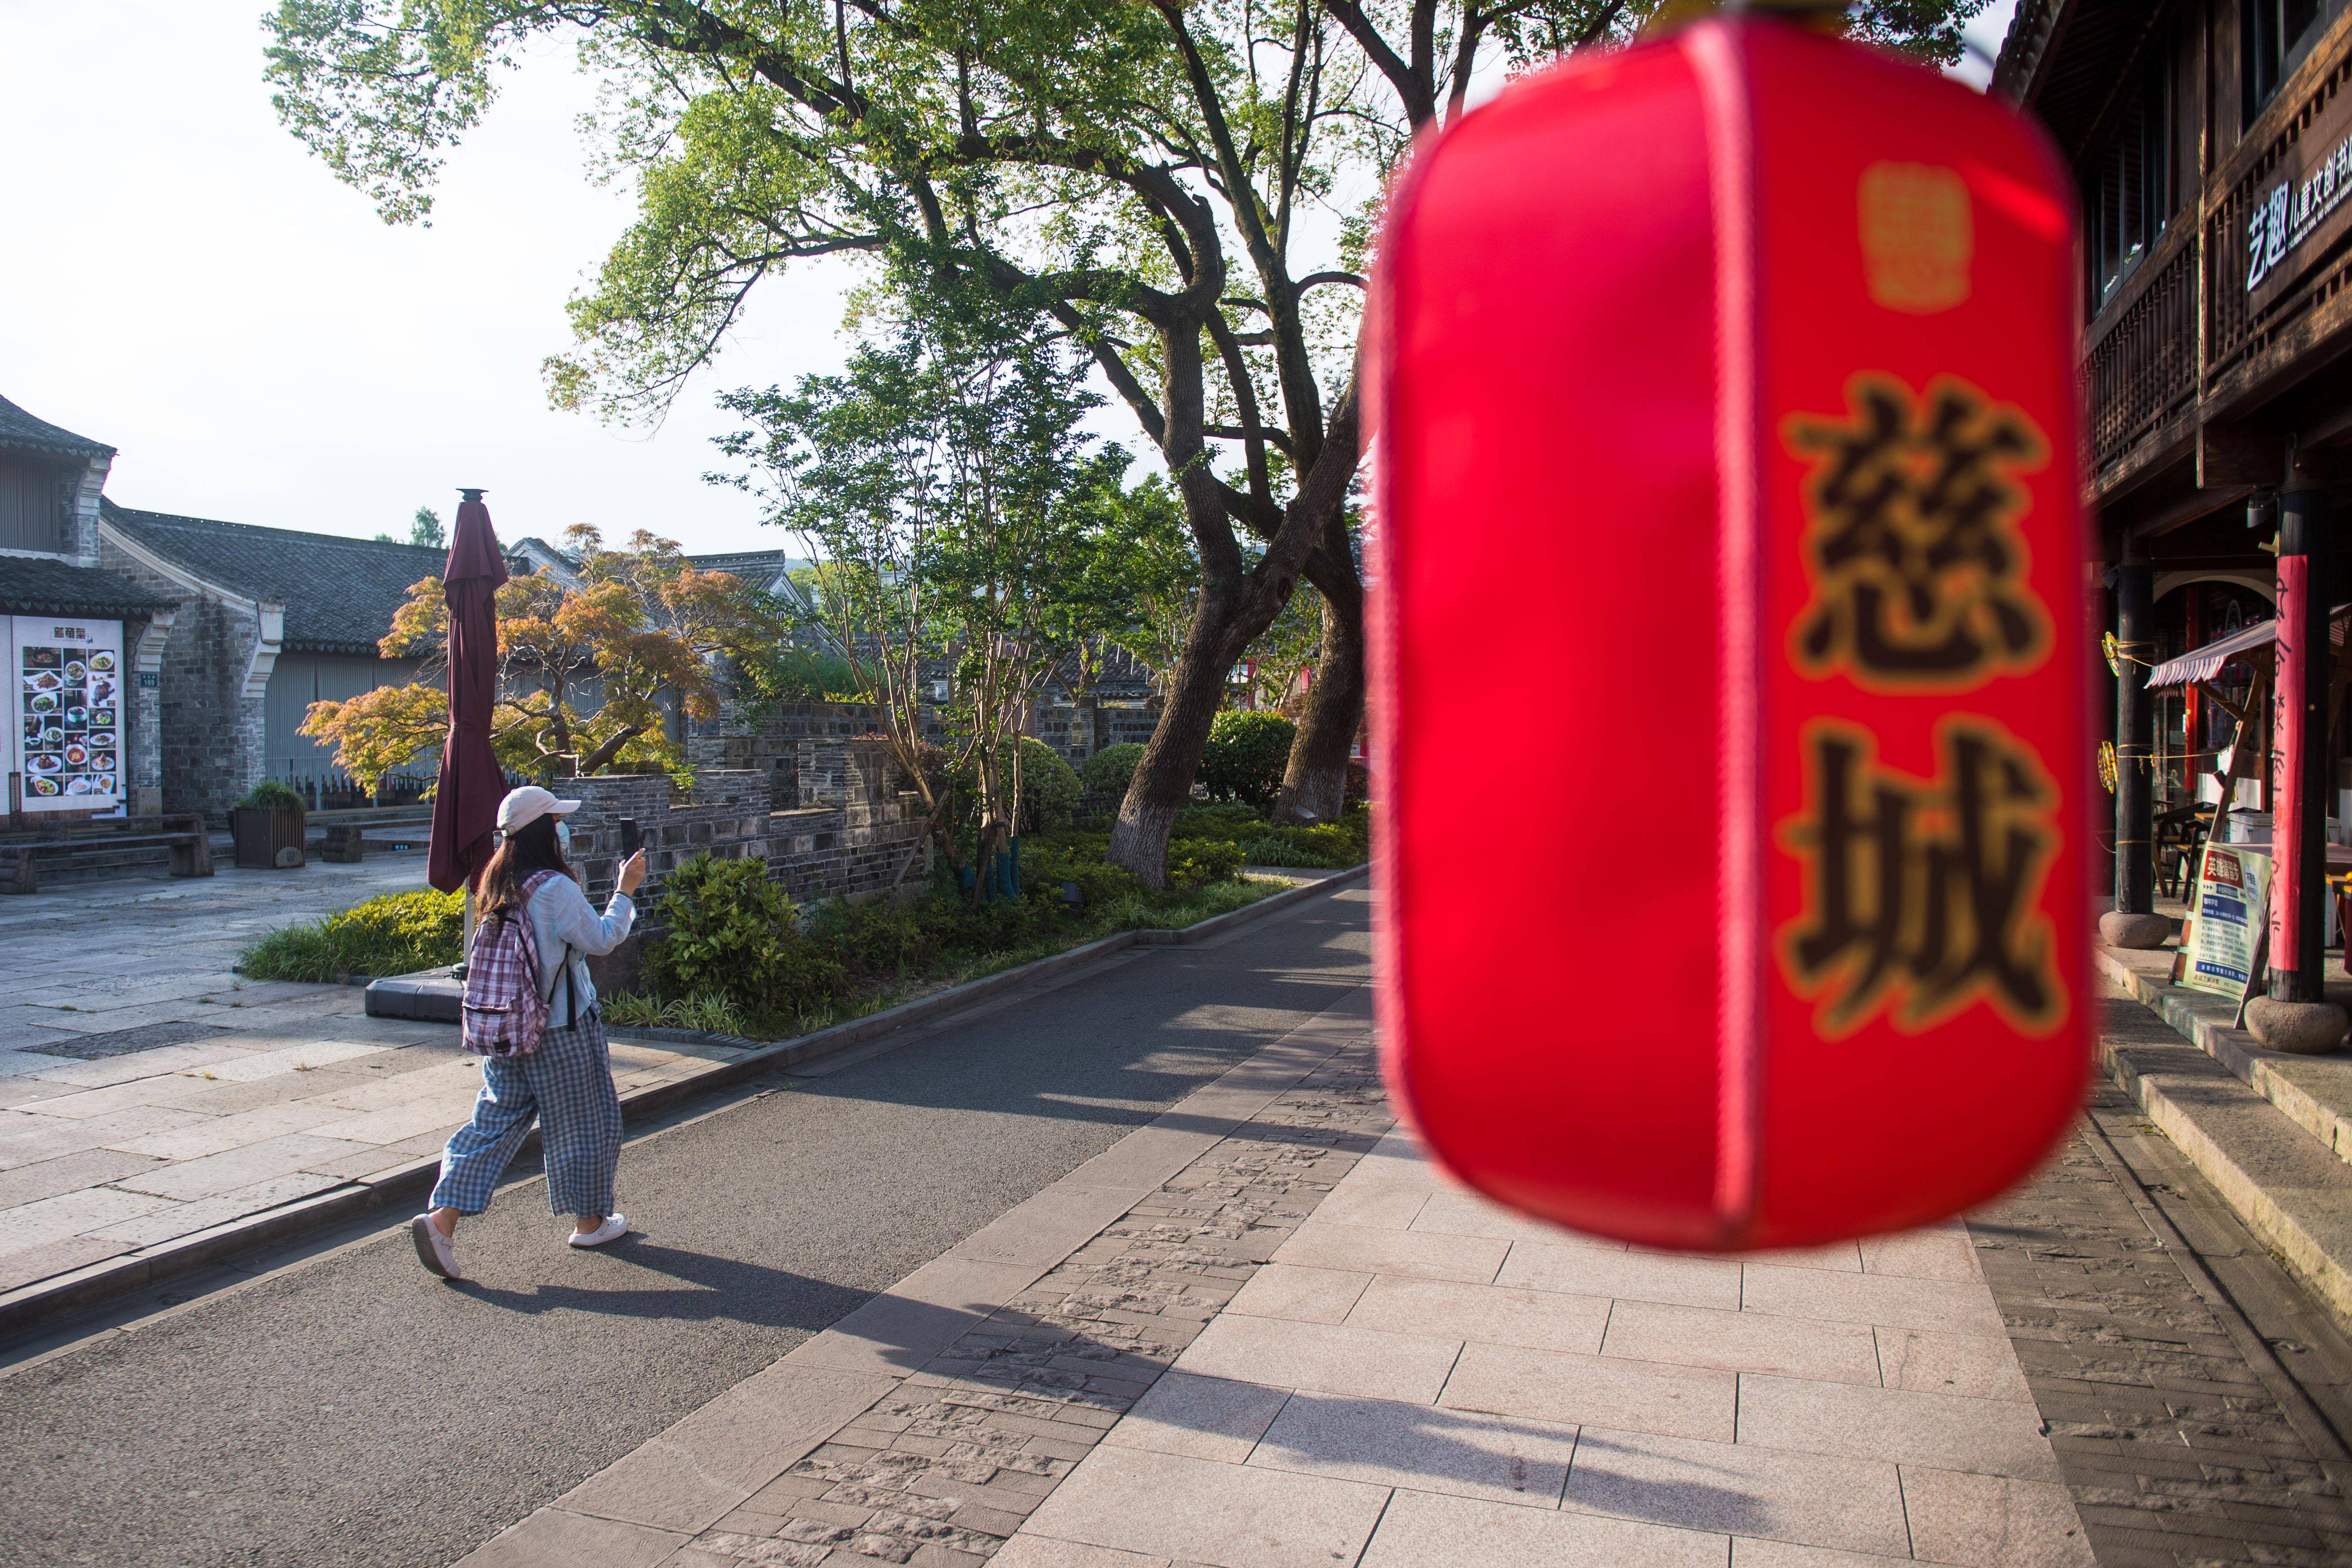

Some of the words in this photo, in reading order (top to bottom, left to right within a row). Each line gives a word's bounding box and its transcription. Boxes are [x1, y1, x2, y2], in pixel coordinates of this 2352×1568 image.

[2247, 180, 2289, 292] 艺趣
[1779, 372, 2069, 1041] 慈城
[2207, 856, 2239, 882] 英雄请留步
